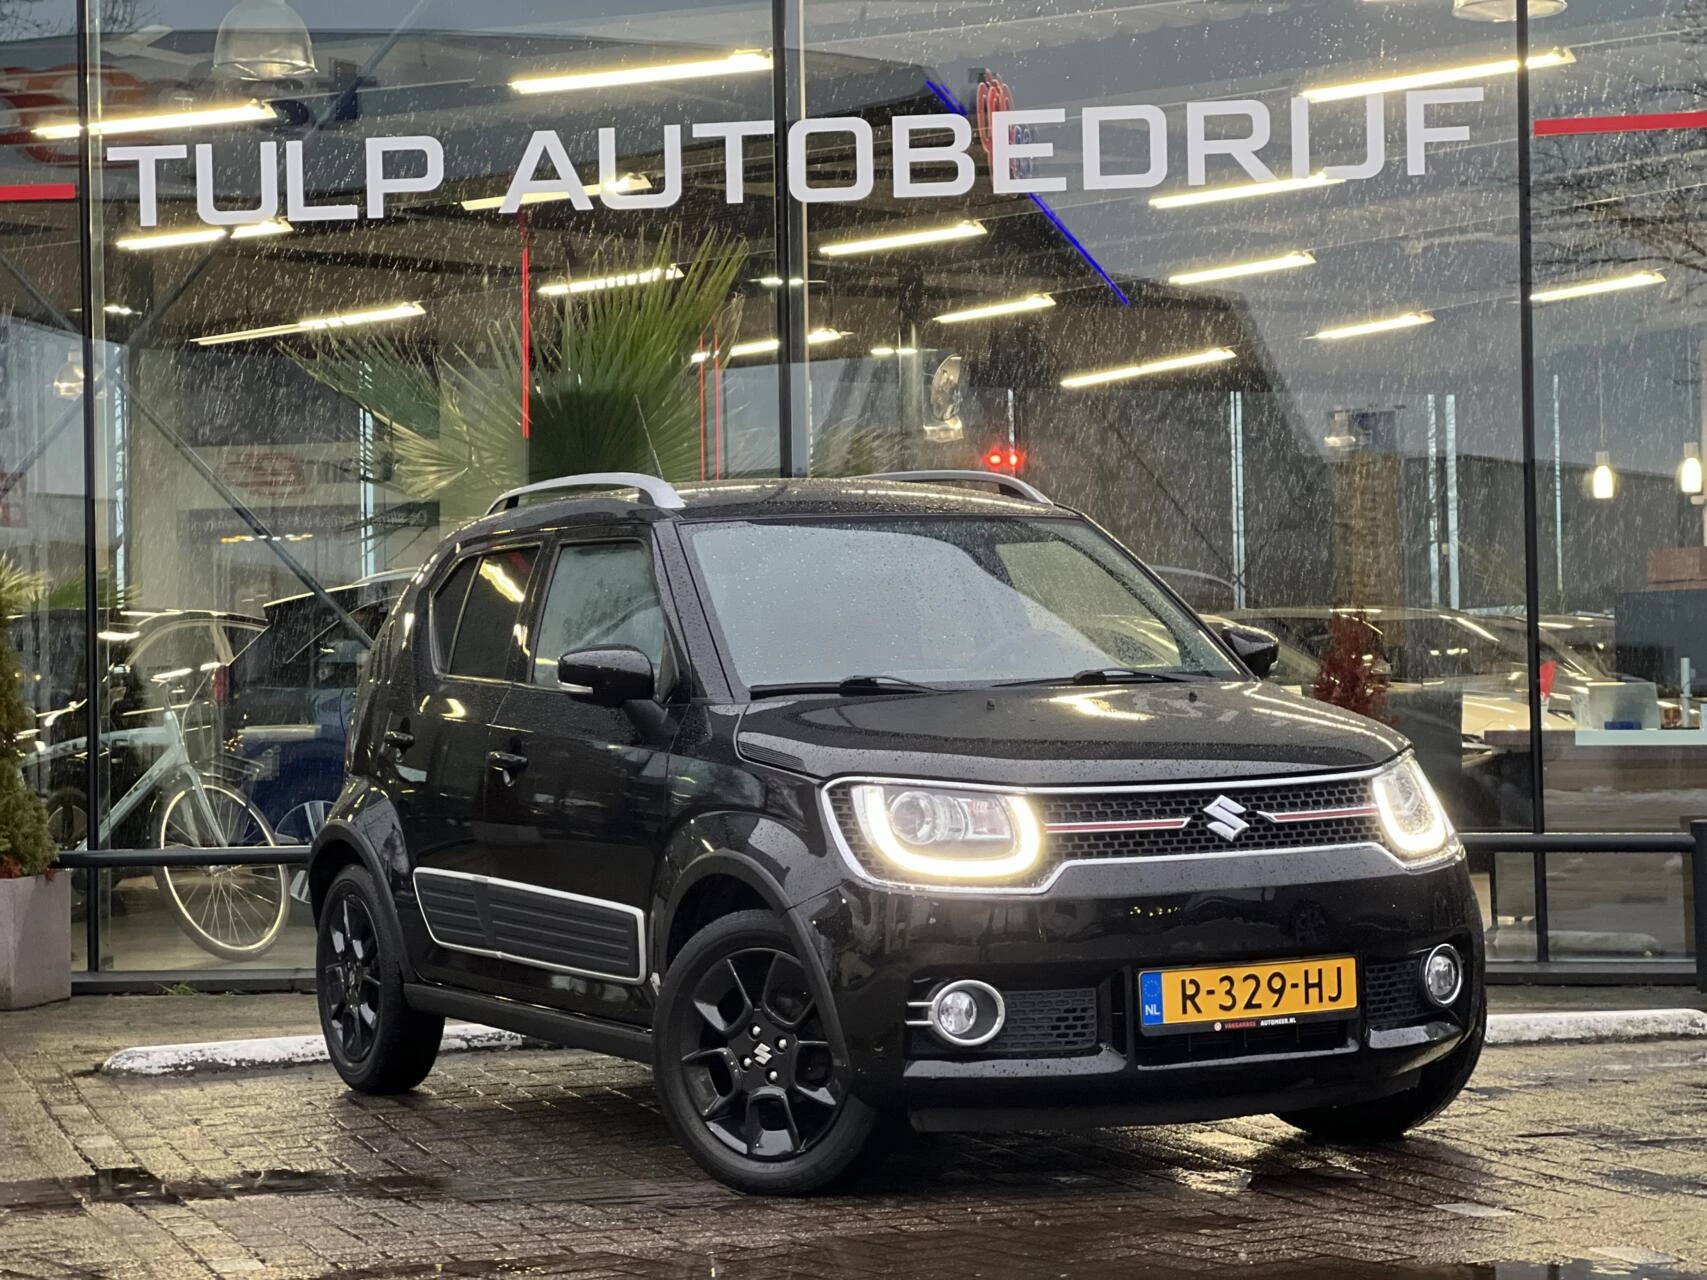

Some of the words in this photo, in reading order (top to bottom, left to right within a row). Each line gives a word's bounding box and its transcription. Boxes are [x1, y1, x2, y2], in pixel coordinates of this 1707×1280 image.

[106, 135, 445, 227] TULP
[498, 87, 1485, 214] AUTOBEDRIJF
[1145, 1004, 1160, 1016] NL
[1180, 966, 1343, 1016] R-329-HJ
